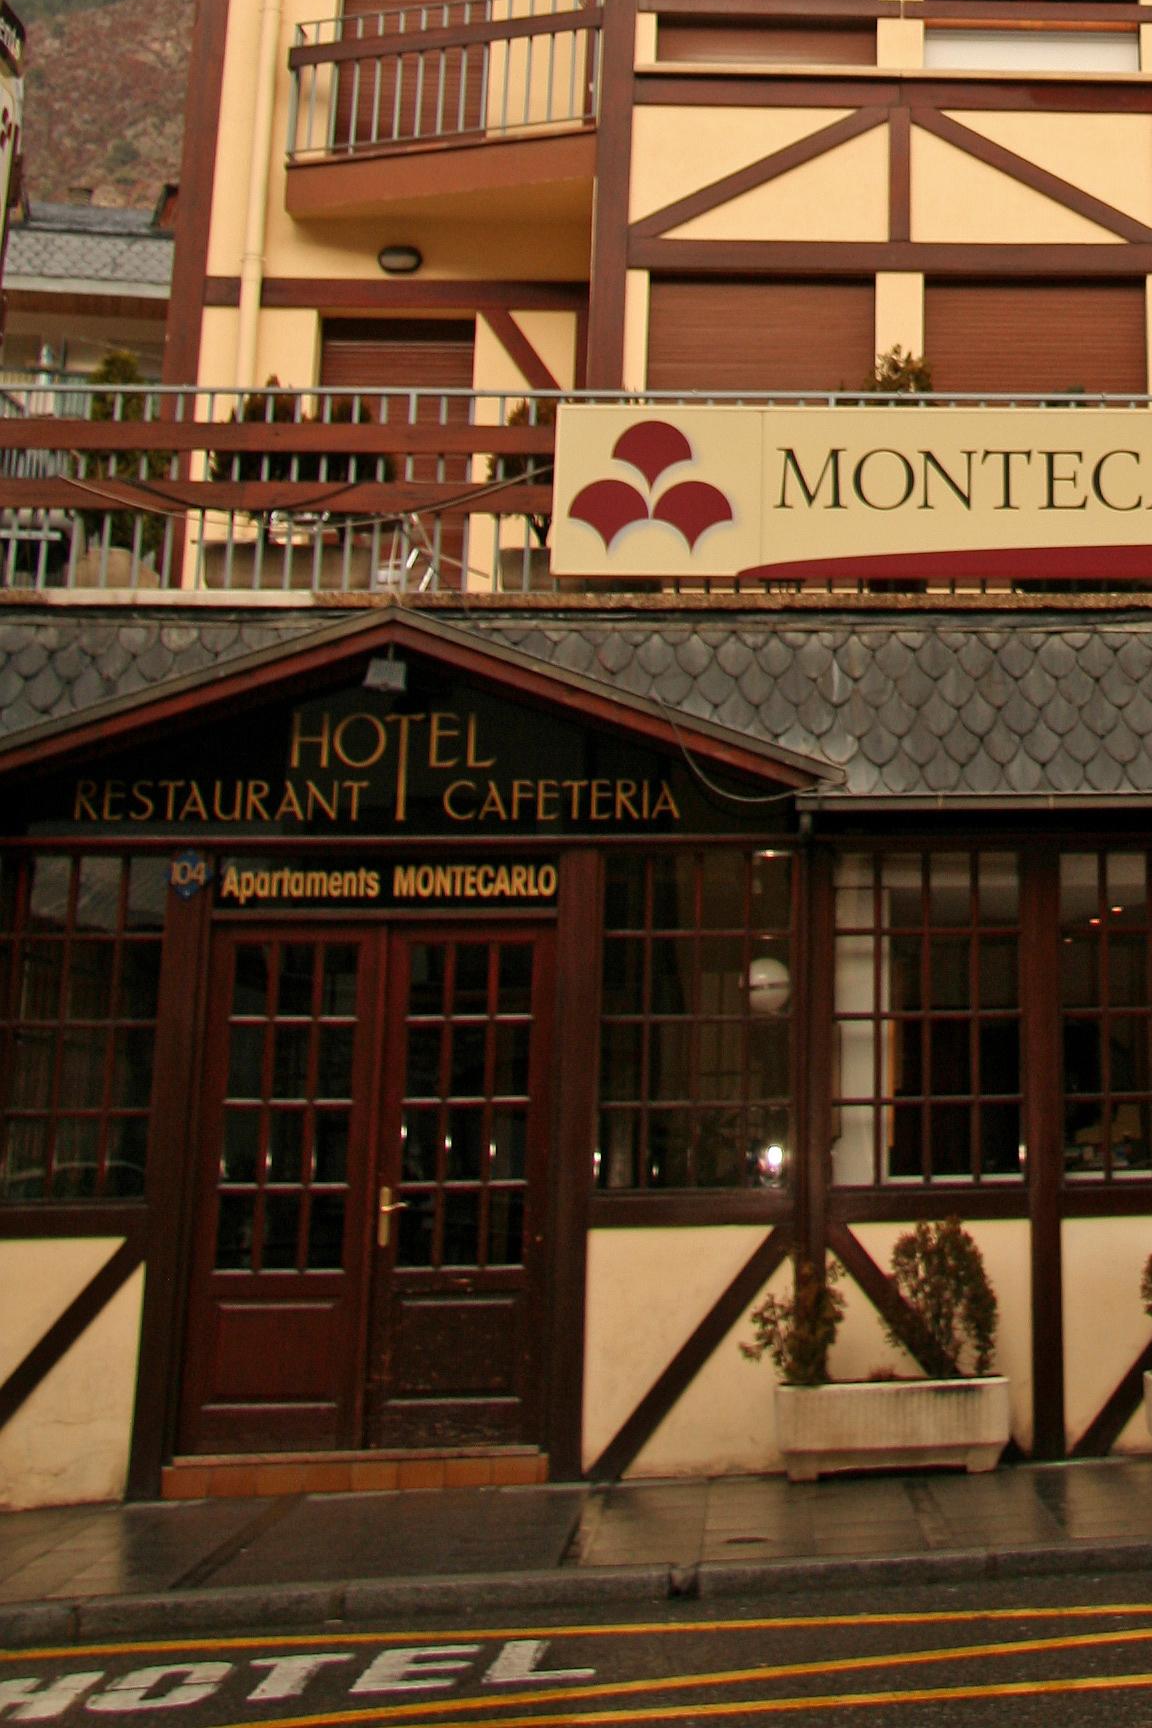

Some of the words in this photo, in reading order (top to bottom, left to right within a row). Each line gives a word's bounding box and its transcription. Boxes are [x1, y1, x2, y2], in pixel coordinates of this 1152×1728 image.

[288, 710, 498, 822] HOTEL
[72, 778, 370, 823] RESTAURANT
[441, 777, 681, 822] CAFETERIA
[169, 861, 206, 887] 104
[221, 865, 380, 903] Apartaments
[393, 864, 557, 897] MONTECARLO
[0, 1639, 598, 1722] HOTEL
